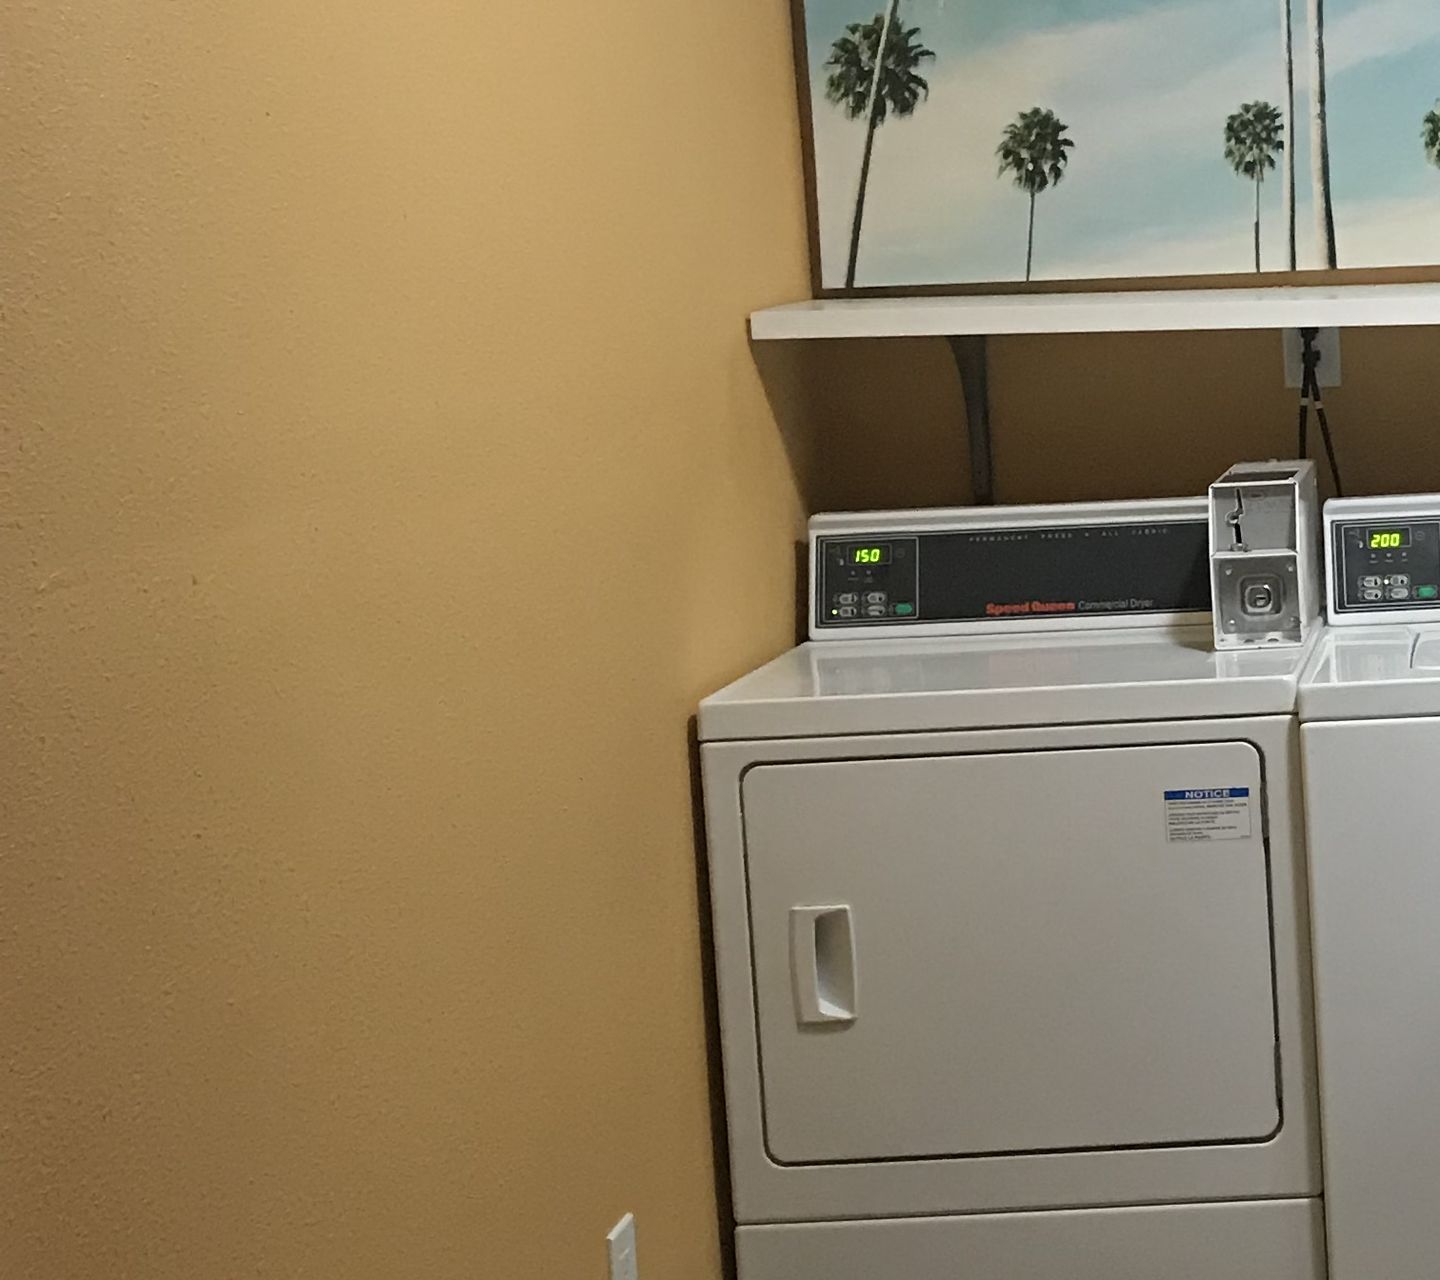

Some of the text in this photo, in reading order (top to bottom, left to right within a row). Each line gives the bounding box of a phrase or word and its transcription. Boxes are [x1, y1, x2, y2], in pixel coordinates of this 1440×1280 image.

[1371, 533, 1400, 548] 200
[855, 548, 880, 563] 150
[986, 598, 1153, 615] Speed Queen Commercial Dryer
[1185, 789, 1230, 799] NOTICE
